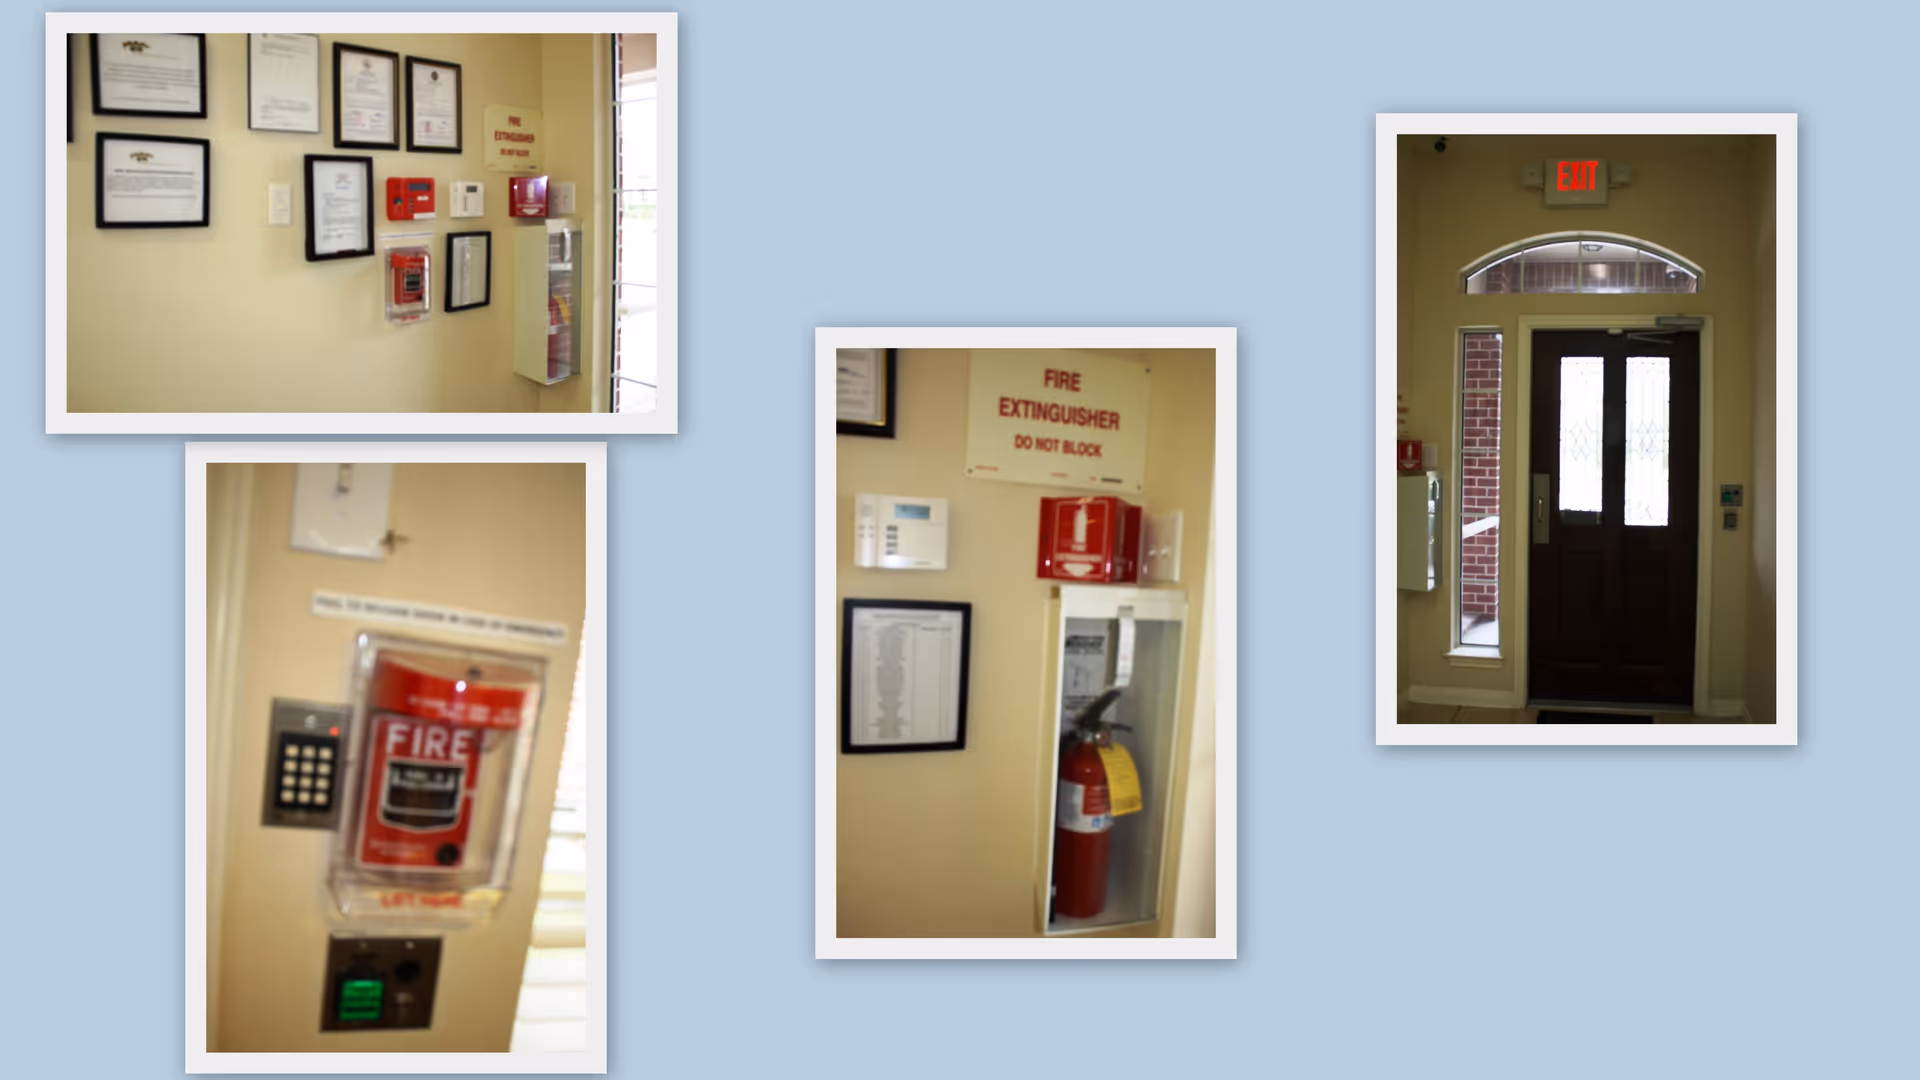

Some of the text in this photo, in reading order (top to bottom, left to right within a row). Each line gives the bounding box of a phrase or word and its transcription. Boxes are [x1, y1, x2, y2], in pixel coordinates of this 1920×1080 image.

[1557, 160, 1598, 191] EXIT
[1044, 368, 1081, 392] FIRE
[998, 397, 1121, 431] EXTINGUISHER
[1014, 434, 1103, 458] DO NOT BLOCK
[385, 722, 476, 761] FIRE
